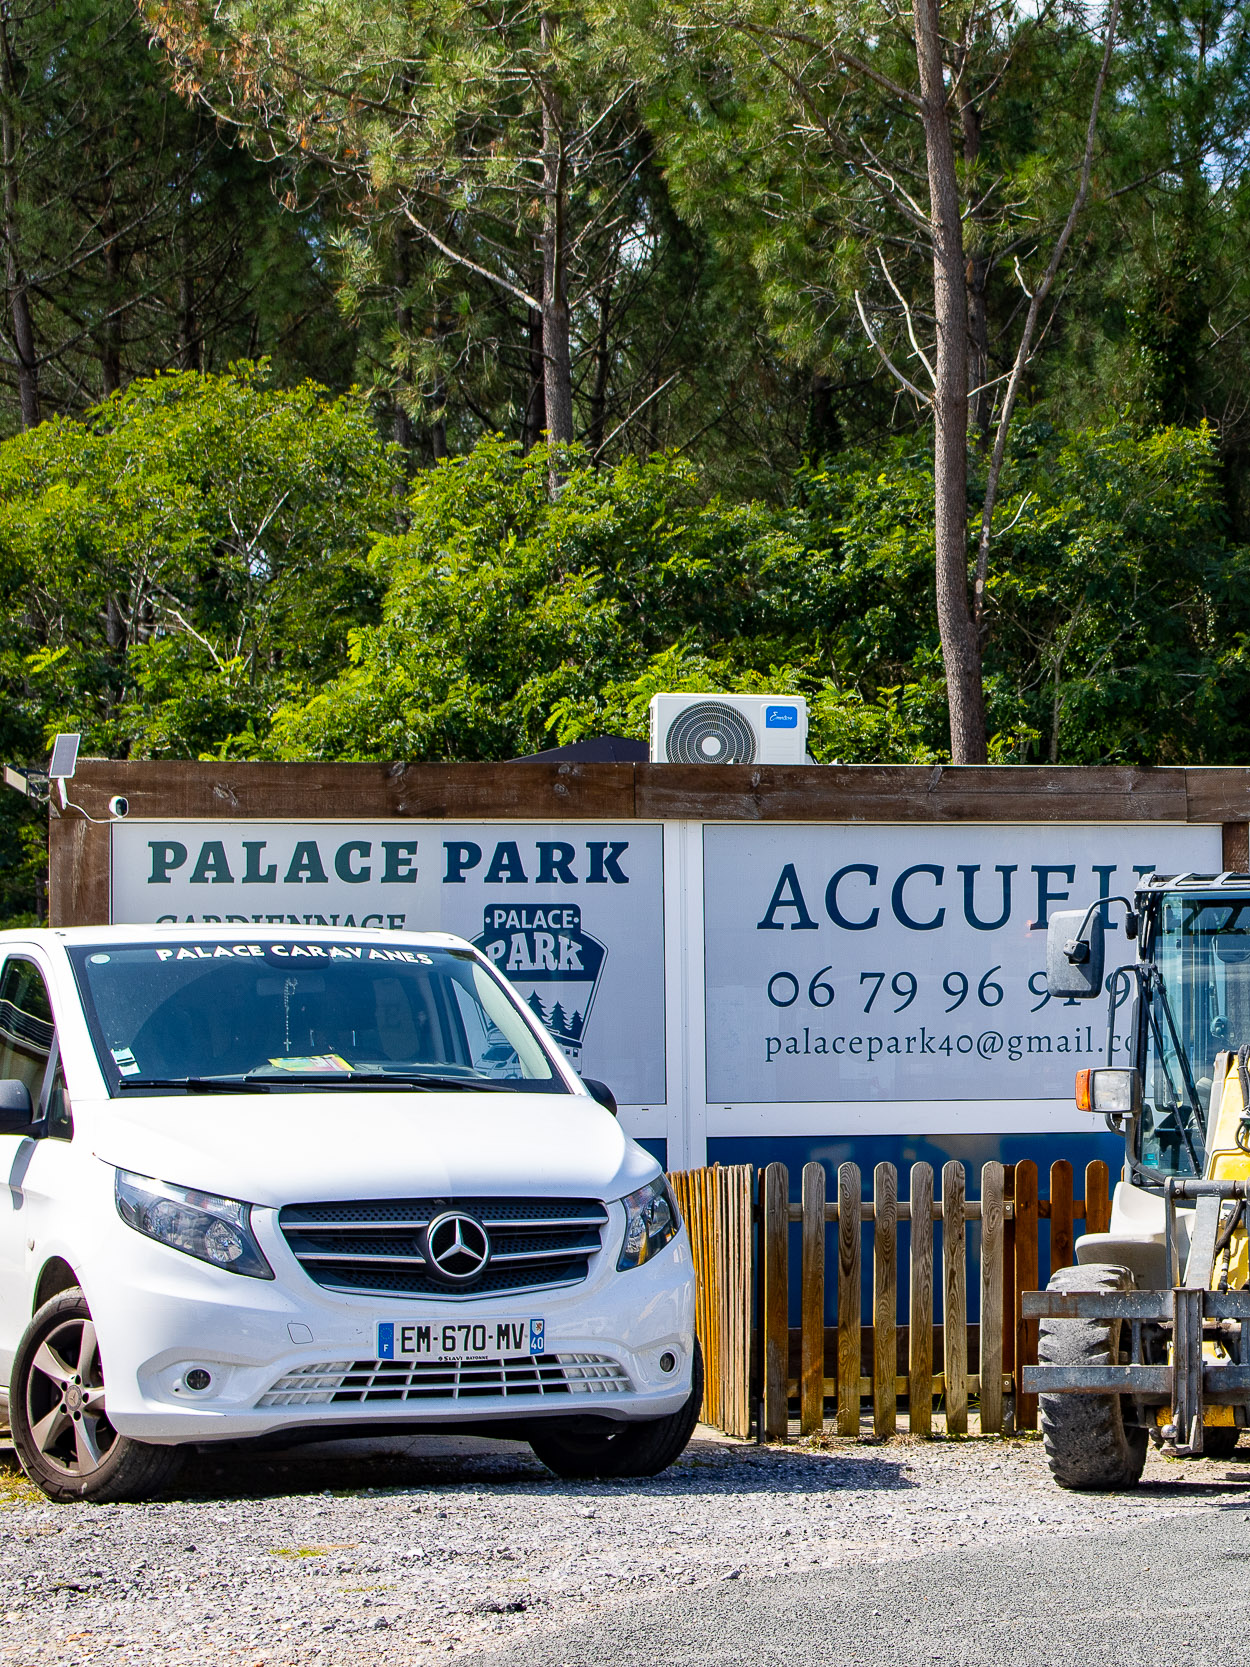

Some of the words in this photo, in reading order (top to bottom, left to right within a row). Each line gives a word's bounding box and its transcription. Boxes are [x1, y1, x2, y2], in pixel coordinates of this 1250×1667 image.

[147, 840, 419, 884] PALACE
[442, 840, 630, 885] PARK
[756, 861, 1157, 931] ACCUEI
[493, 909, 575, 929] PALACE
[155, 944, 266, 962] PALACE
[270, 944, 434, 966] CARAVANES
[485, 931, 585, 971] PARK
[767, 965, 836, 1009] 06
[858, 970, 919, 1014] 79
[941, 965, 1005, 1014] 96
[1028, 971, 1083, 1013] 9
[383, 1344, 389, 1353] F
[401, 1322, 525, 1354] EM-670-MV
[530, 1337, 544, 1351] 40
